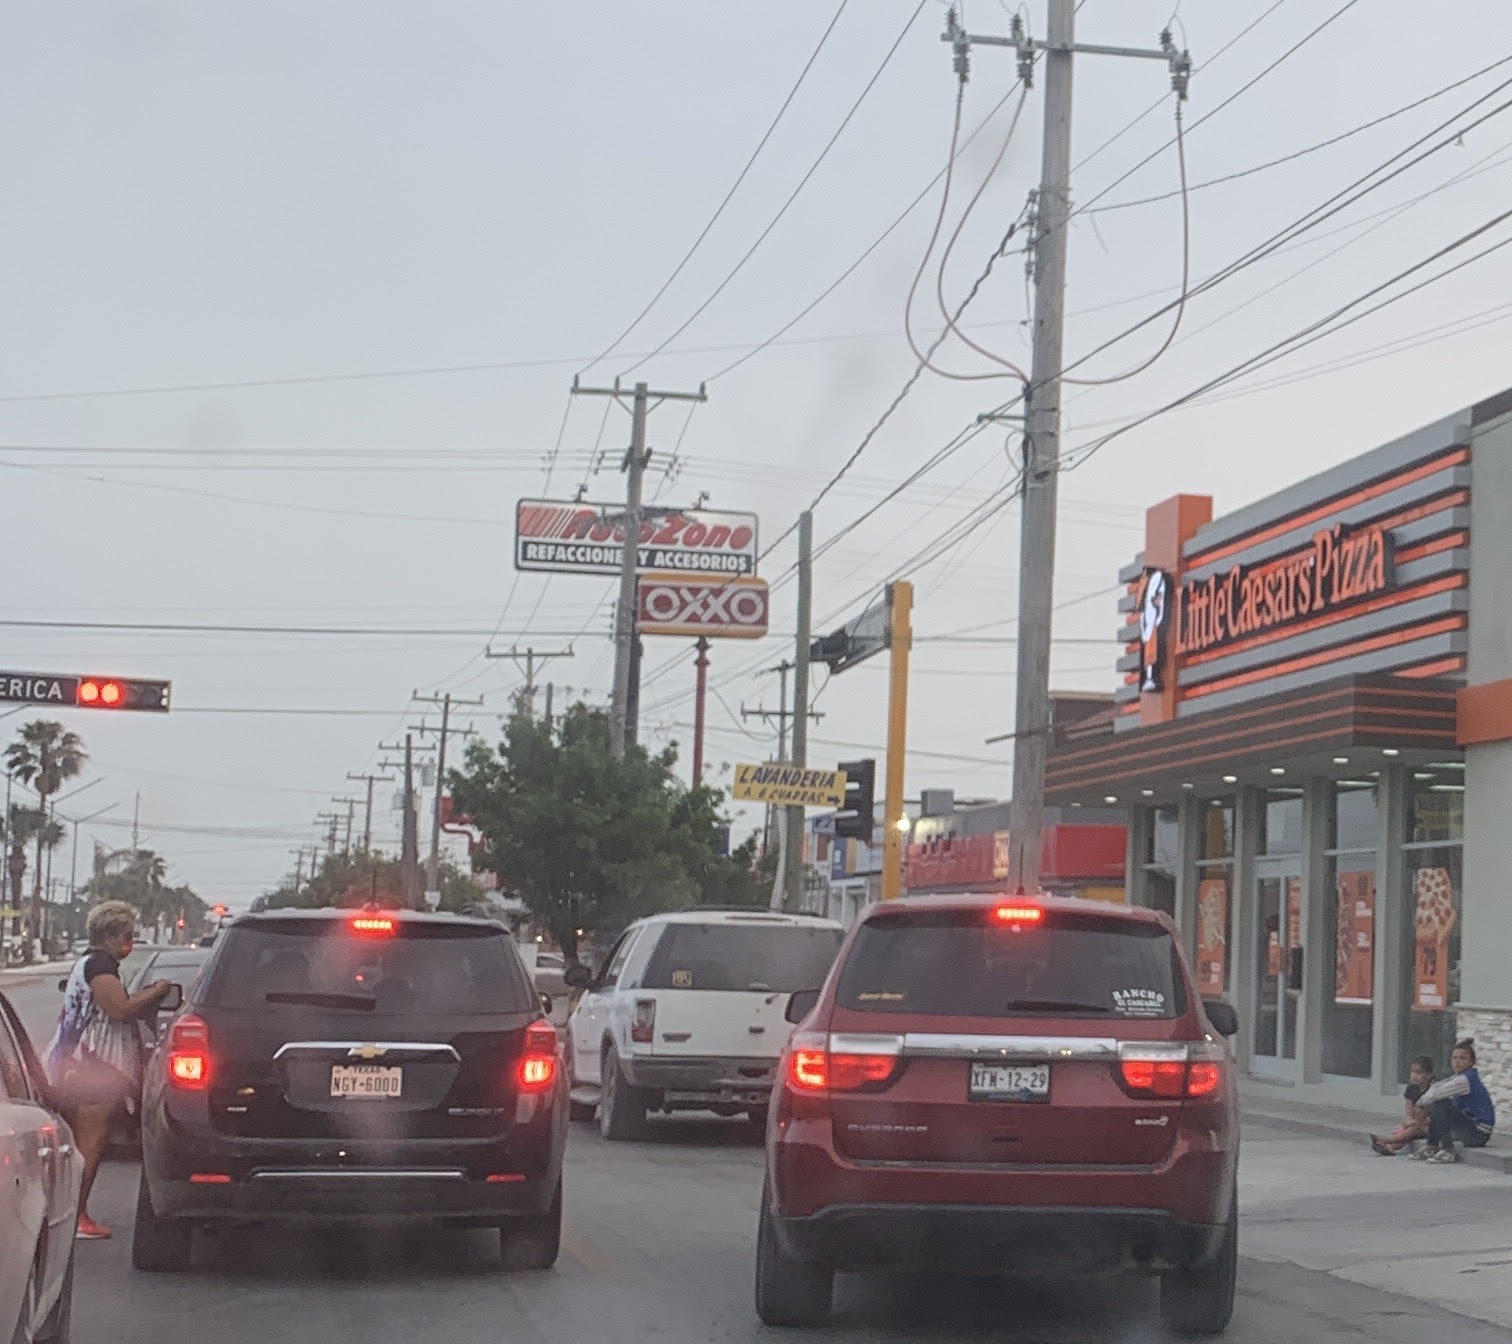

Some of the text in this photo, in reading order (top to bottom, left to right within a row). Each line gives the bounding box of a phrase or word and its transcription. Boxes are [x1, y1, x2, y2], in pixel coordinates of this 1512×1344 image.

[526, 542, 748, 572] REFACCIONE Y ACCESORIOS
[1175, 523, 1385, 655] Little Caesars Pizza
[646, 587, 765, 624] OXXO
[739, 766, 836, 789] LAVANDERIA
[1112, 989, 1164, 1002] RANCHO
